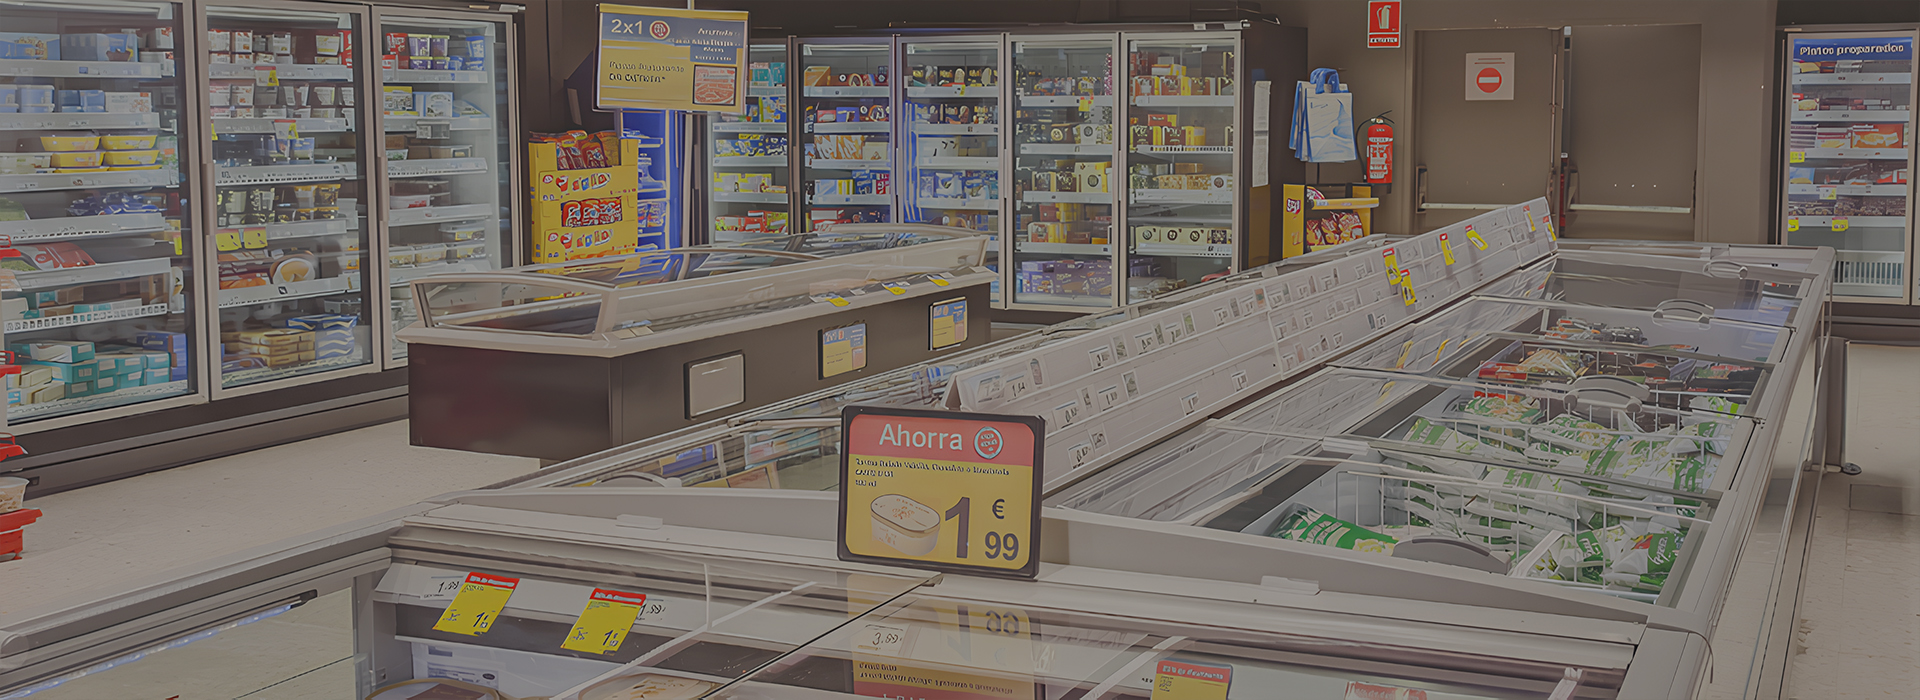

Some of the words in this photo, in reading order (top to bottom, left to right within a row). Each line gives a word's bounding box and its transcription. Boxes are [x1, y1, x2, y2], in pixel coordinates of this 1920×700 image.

[611, 18, 643, 35] 2x1
[879, 423, 963, 451] Ahorra
[992, 498, 1006, 520] €
[945, 496, 971, 558] 1
[984, 531, 1019, 561] 99
